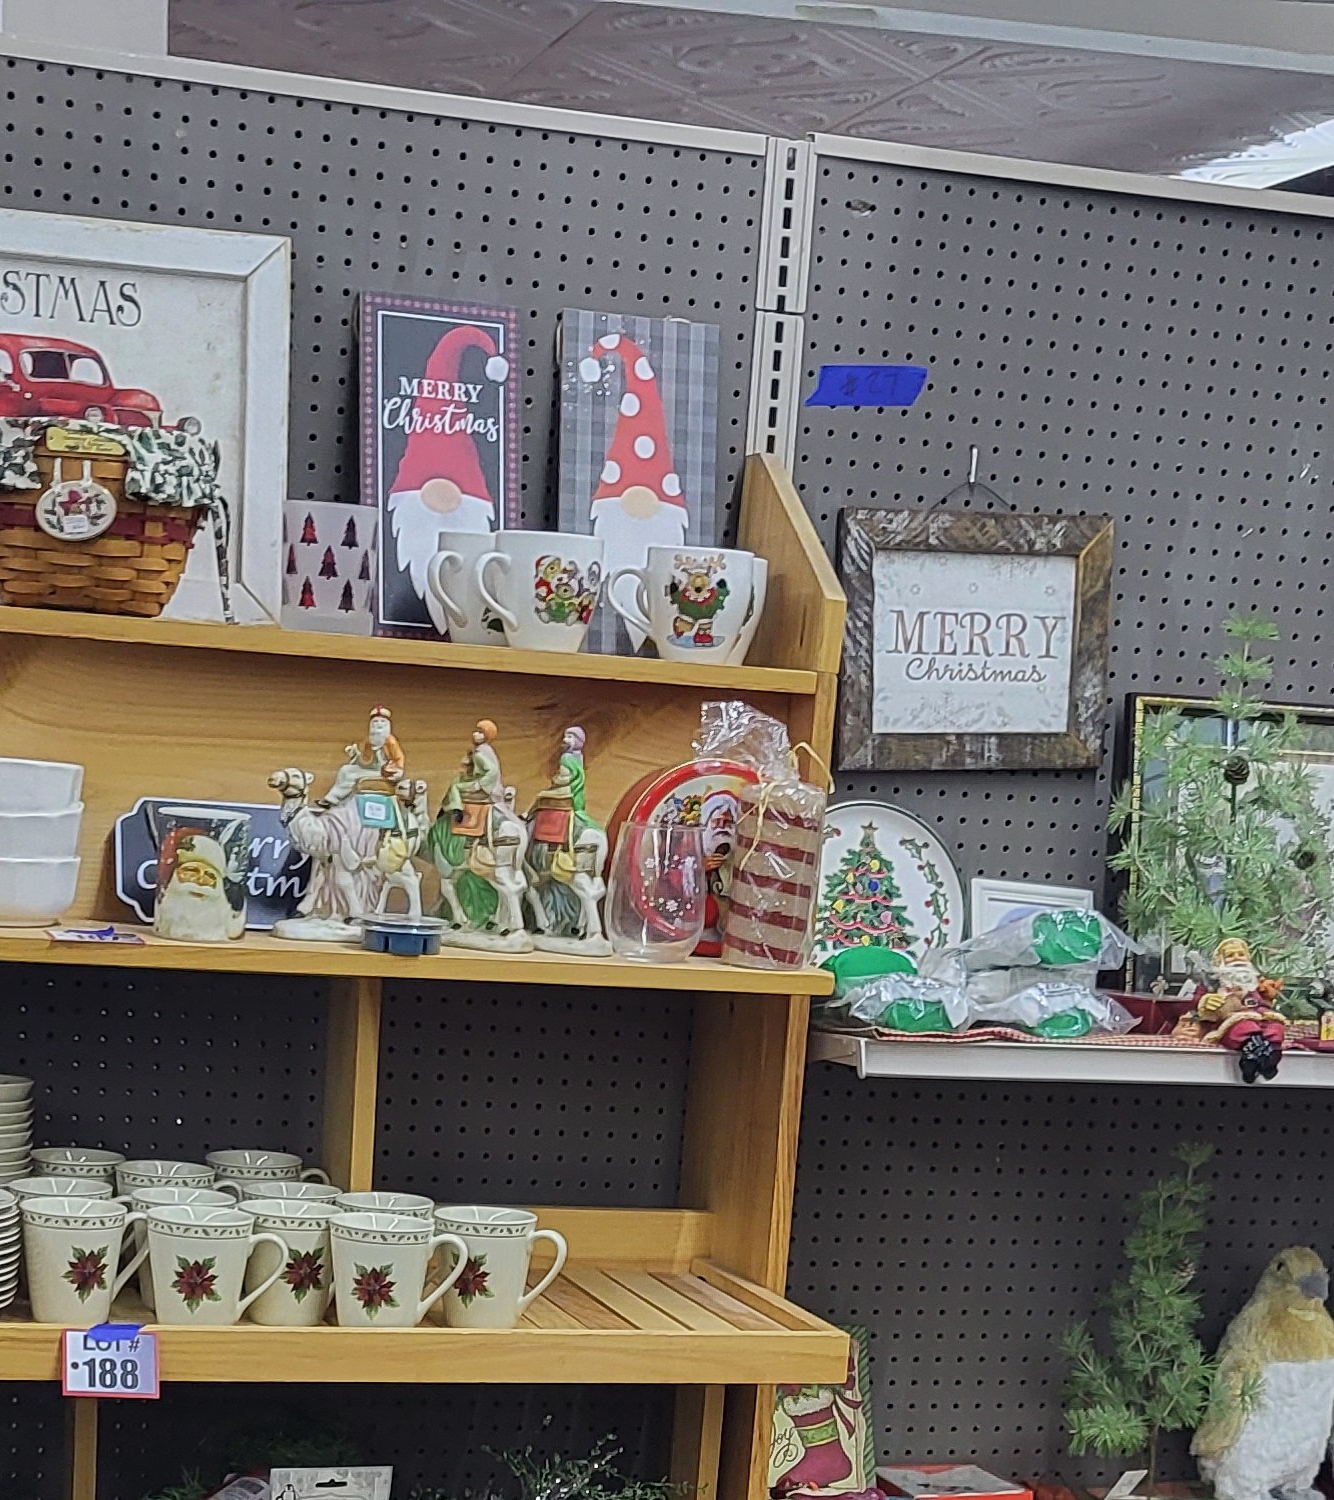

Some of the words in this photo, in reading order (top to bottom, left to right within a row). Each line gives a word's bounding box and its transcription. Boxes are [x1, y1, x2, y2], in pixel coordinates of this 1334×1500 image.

[398, 376, 484, 403] MERRY
[383, 397, 500, 442] Christmas
[885, 609, 1067, 660] MERRY
[905, 656, 1048, 683] Christmas
[82, 1358, 139, 1390] 188
